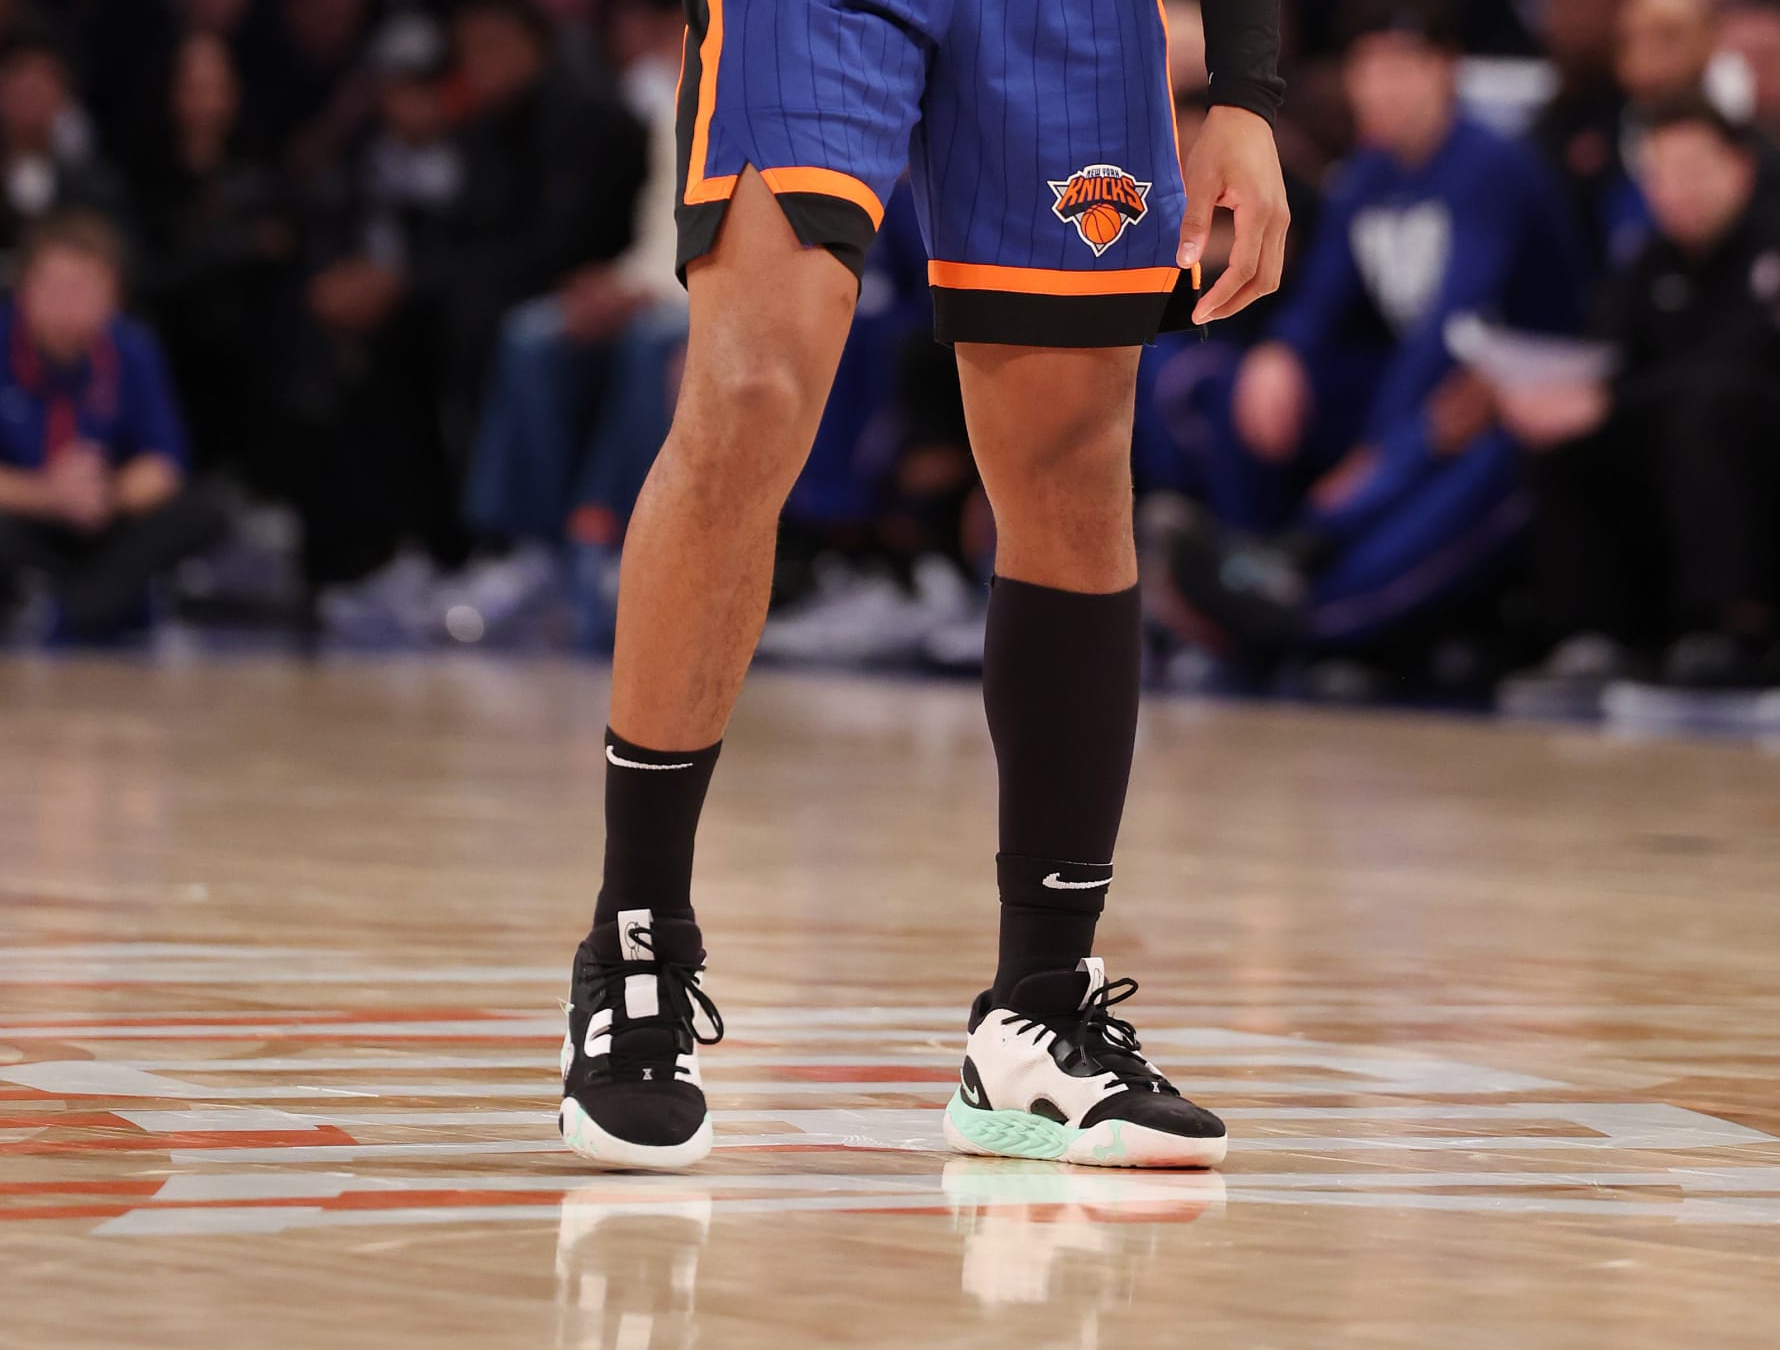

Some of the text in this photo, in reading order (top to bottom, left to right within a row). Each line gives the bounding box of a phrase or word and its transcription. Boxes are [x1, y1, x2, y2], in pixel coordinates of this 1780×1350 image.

[1086, 167, 1120, 178] NEW YORK
[1057, 175, 1145, 212] KNICKS
